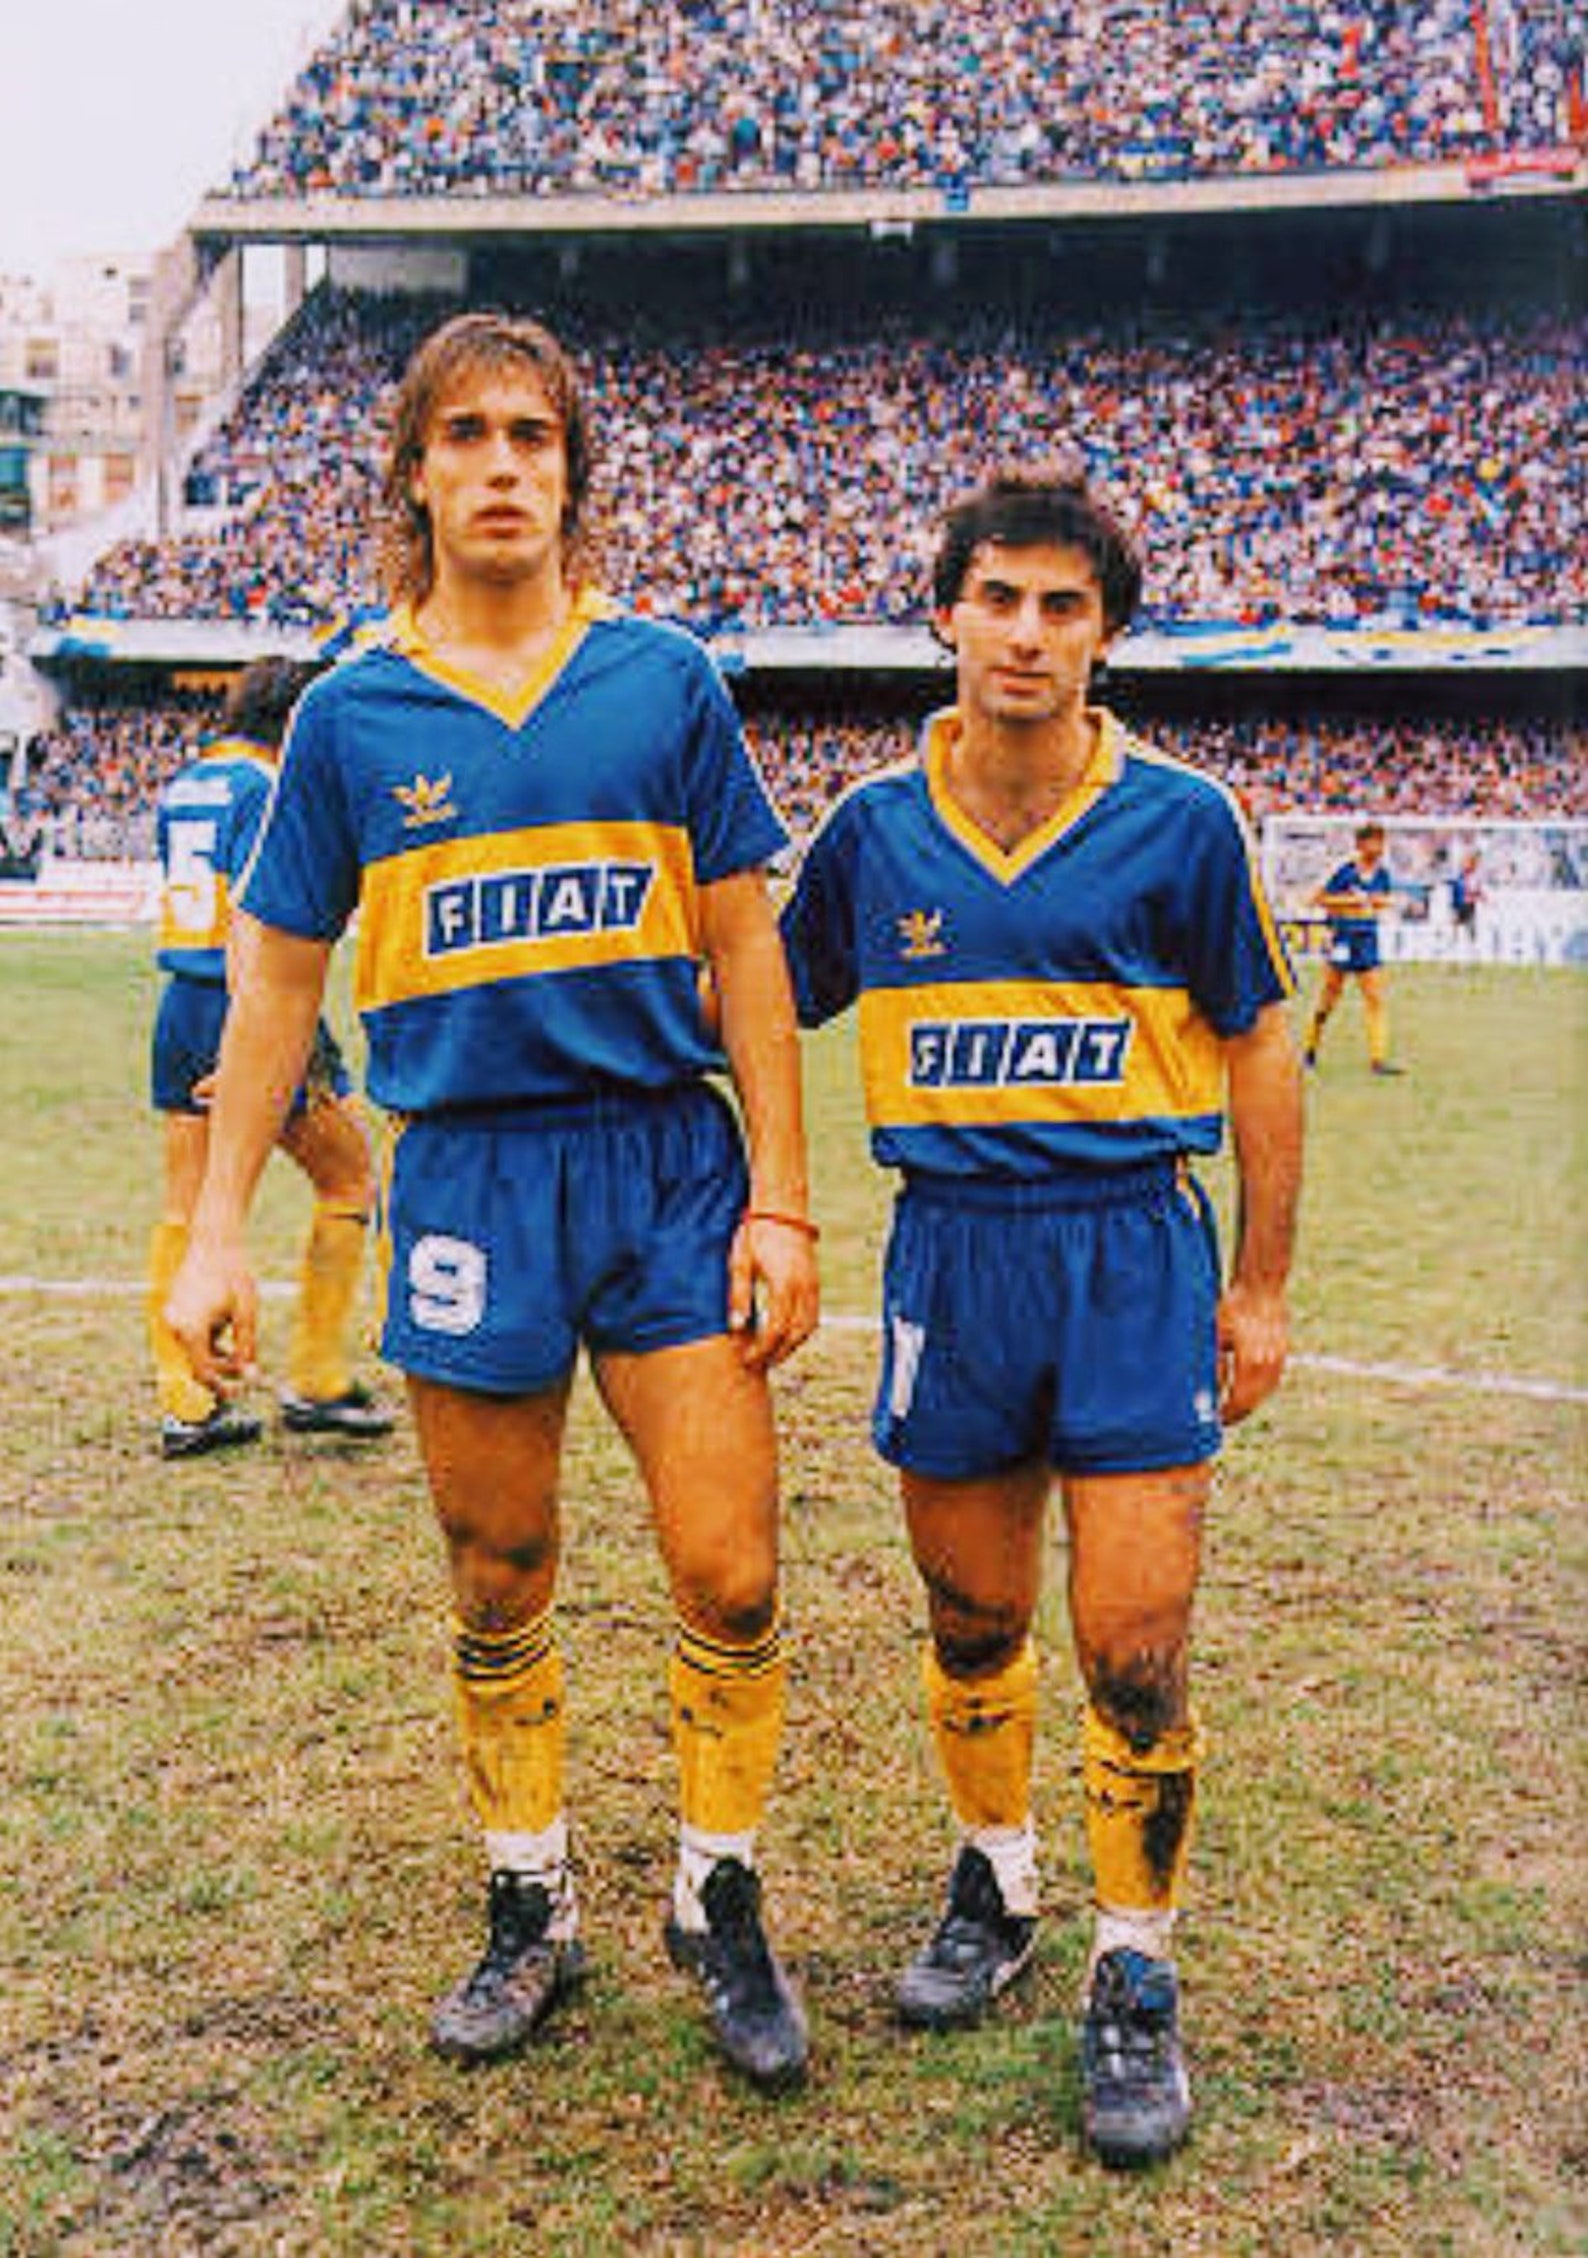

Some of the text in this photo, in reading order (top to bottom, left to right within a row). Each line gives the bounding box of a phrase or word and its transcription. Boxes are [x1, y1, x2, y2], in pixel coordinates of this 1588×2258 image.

[167, 819, 217, 931] 5
[434, 872, 640, 946] FIAT
[913, 1029, 1122, 1080] FIAT
[409, 1233, 488, 1335] 9
